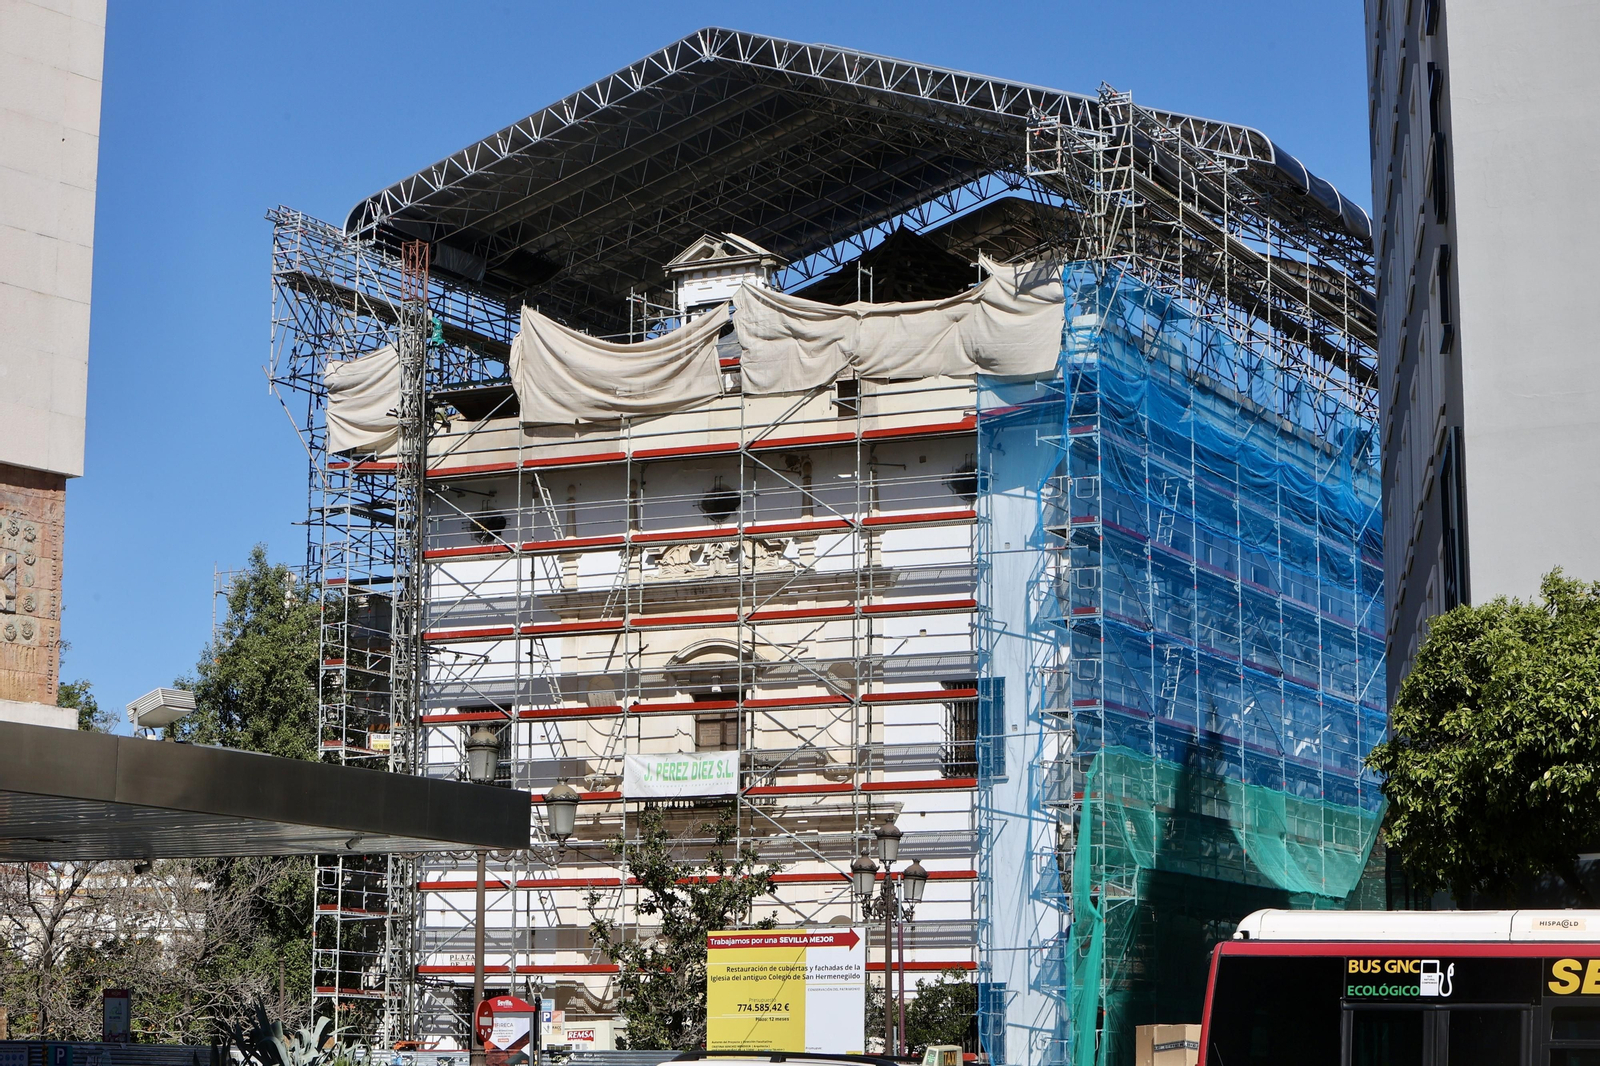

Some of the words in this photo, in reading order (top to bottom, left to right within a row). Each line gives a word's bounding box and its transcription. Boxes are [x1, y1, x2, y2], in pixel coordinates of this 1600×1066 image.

[644, 763, 652, 782] J.
[656, 758, 689, 782] PÉREZ
[691, 757, 714, 780] DÍEZ
[716, 760, 734, 778] S.L.
[710, 938, 750, 946] Trabajamos
[1348, 960, 1381, 974] BUS
[1384, 960, 1420, 974] GNC
[768, 974, 792, 982] Colegio
[1348, 983, 1420, 996] ECOLÓGICO
[737, 1003, 782, 1012] 774.585,42
[784, 1003, 790, 1011] €
[543, 1012, 550, 1022] P
[56, 1048, 65, 1064] P
